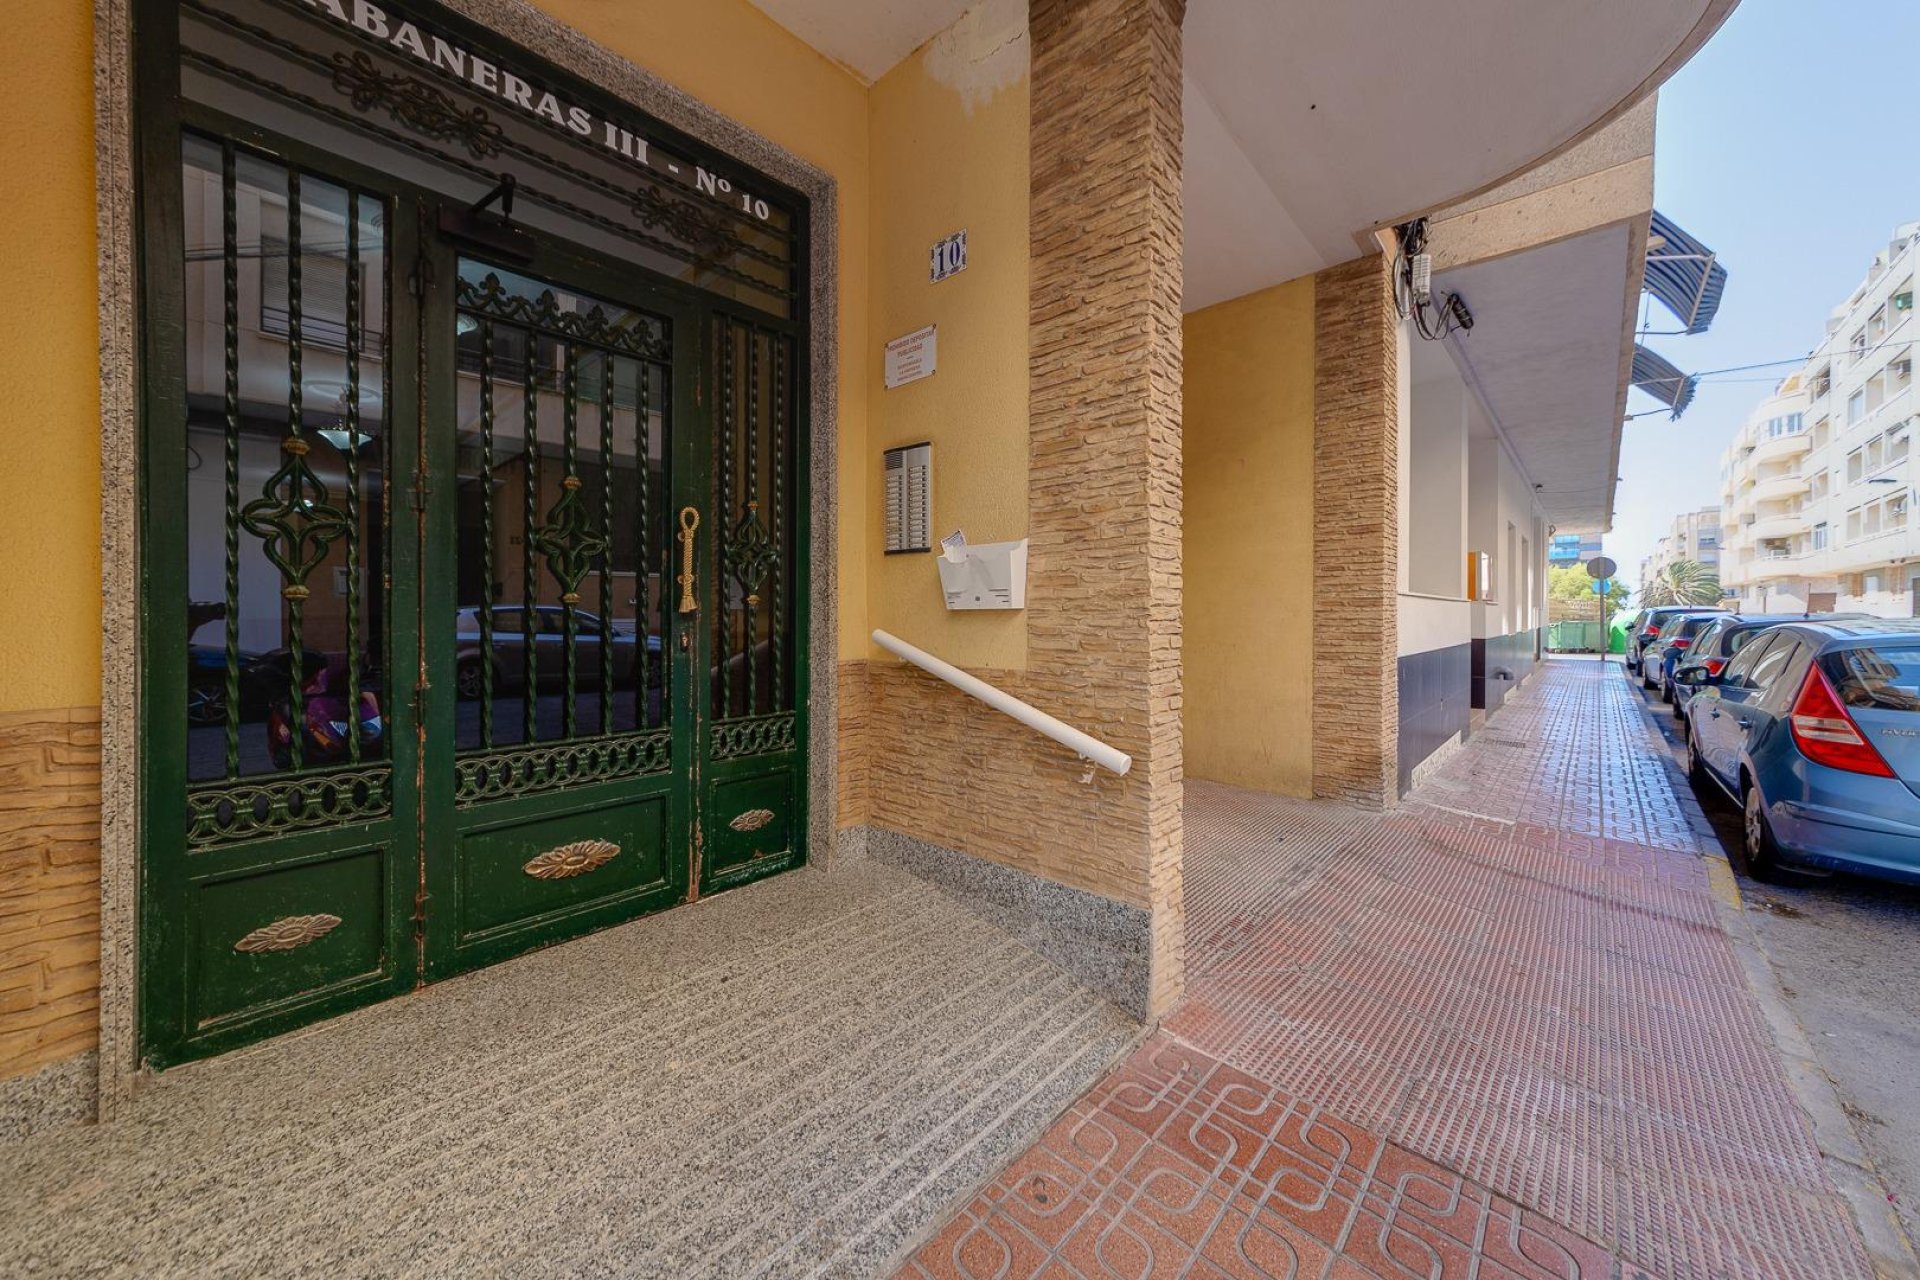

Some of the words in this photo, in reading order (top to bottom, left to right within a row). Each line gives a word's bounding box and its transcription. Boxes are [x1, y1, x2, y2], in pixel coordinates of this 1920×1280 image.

[604, 121, 649, 165] III
[742, 193, 769, 220] 10
[937, 241, 961, 272] 10
